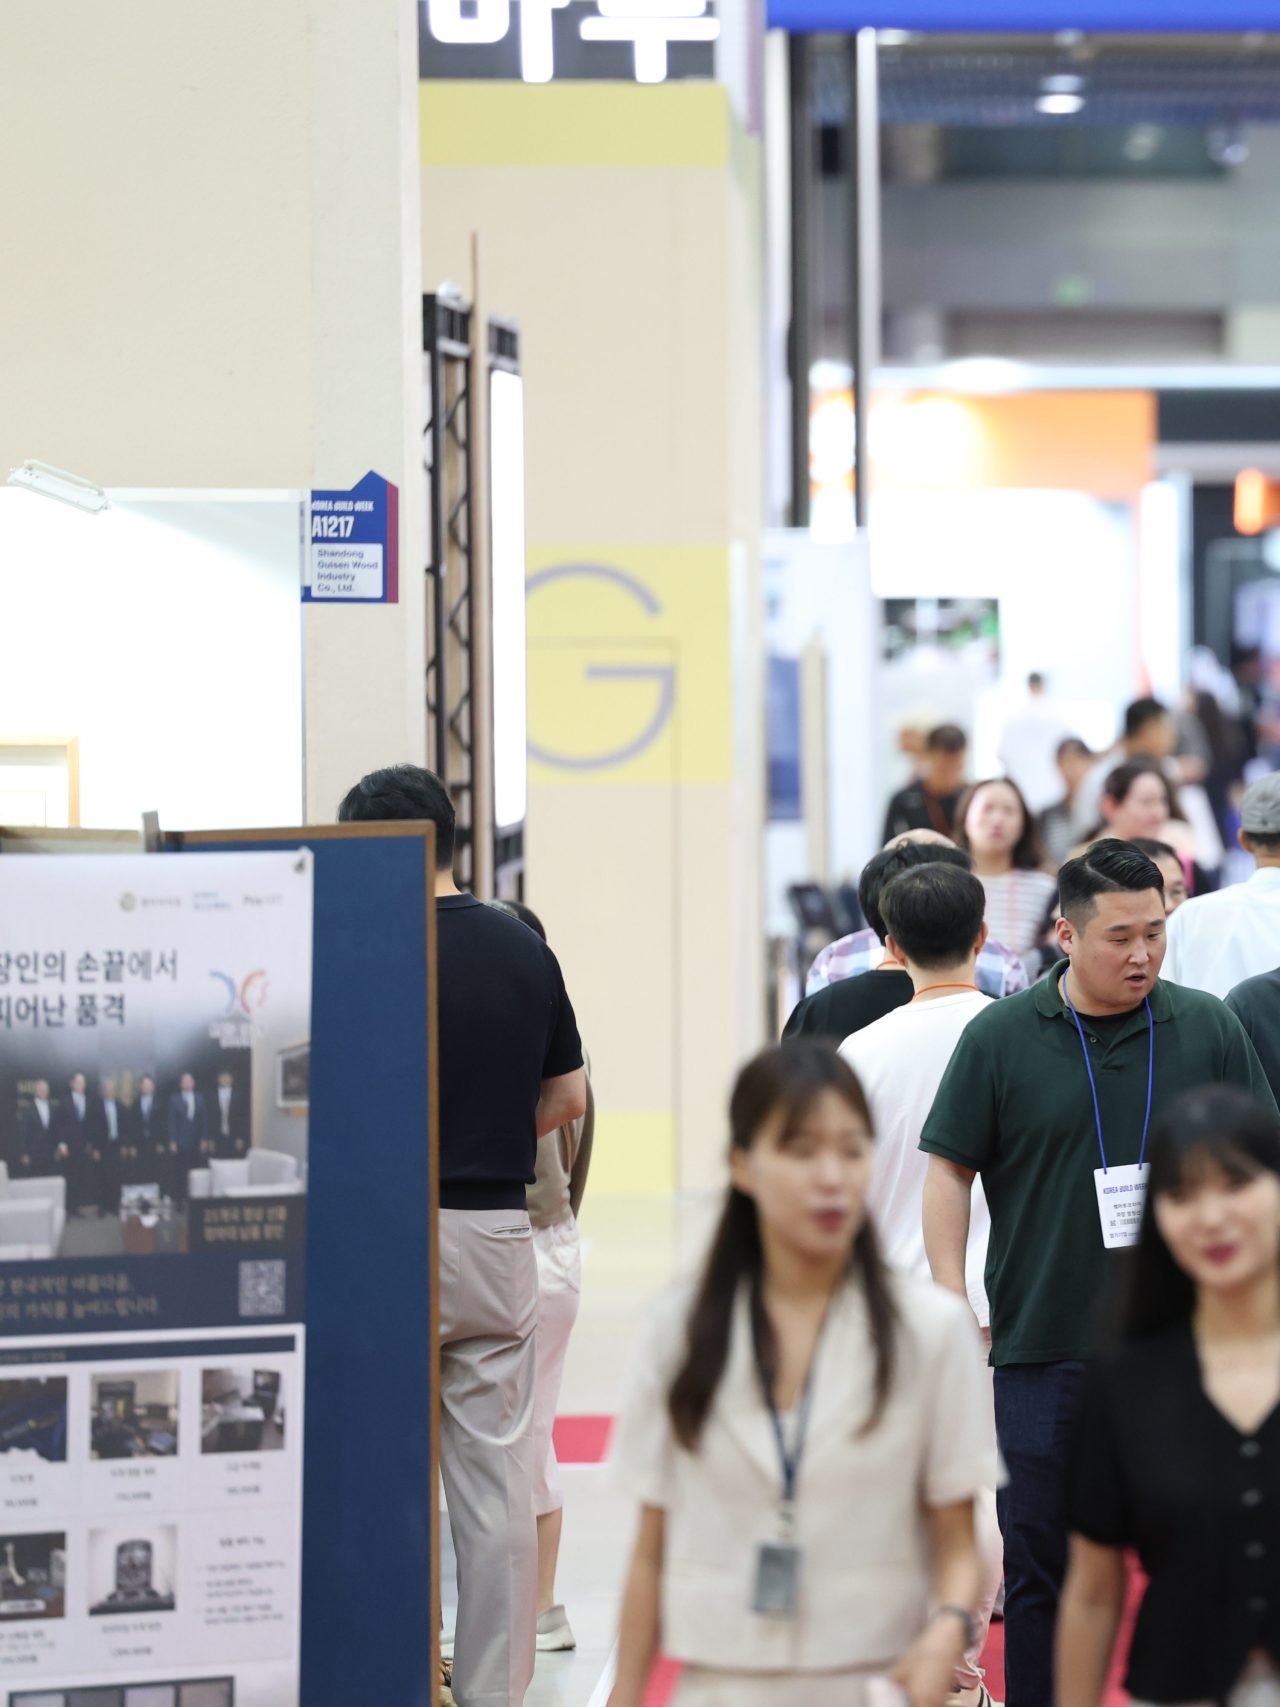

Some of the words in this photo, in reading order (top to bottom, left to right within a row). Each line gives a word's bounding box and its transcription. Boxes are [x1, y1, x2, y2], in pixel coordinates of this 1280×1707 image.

[311, 515, 354, 538] A1217
[317, 549, 364, 559] Shandong
[352, 561, 379, 569] Wood
[317, 572, 356, 581] Industry
[76, 950, 177, 983] 손끝에서
[77, 993, 125, 1027] 품격
